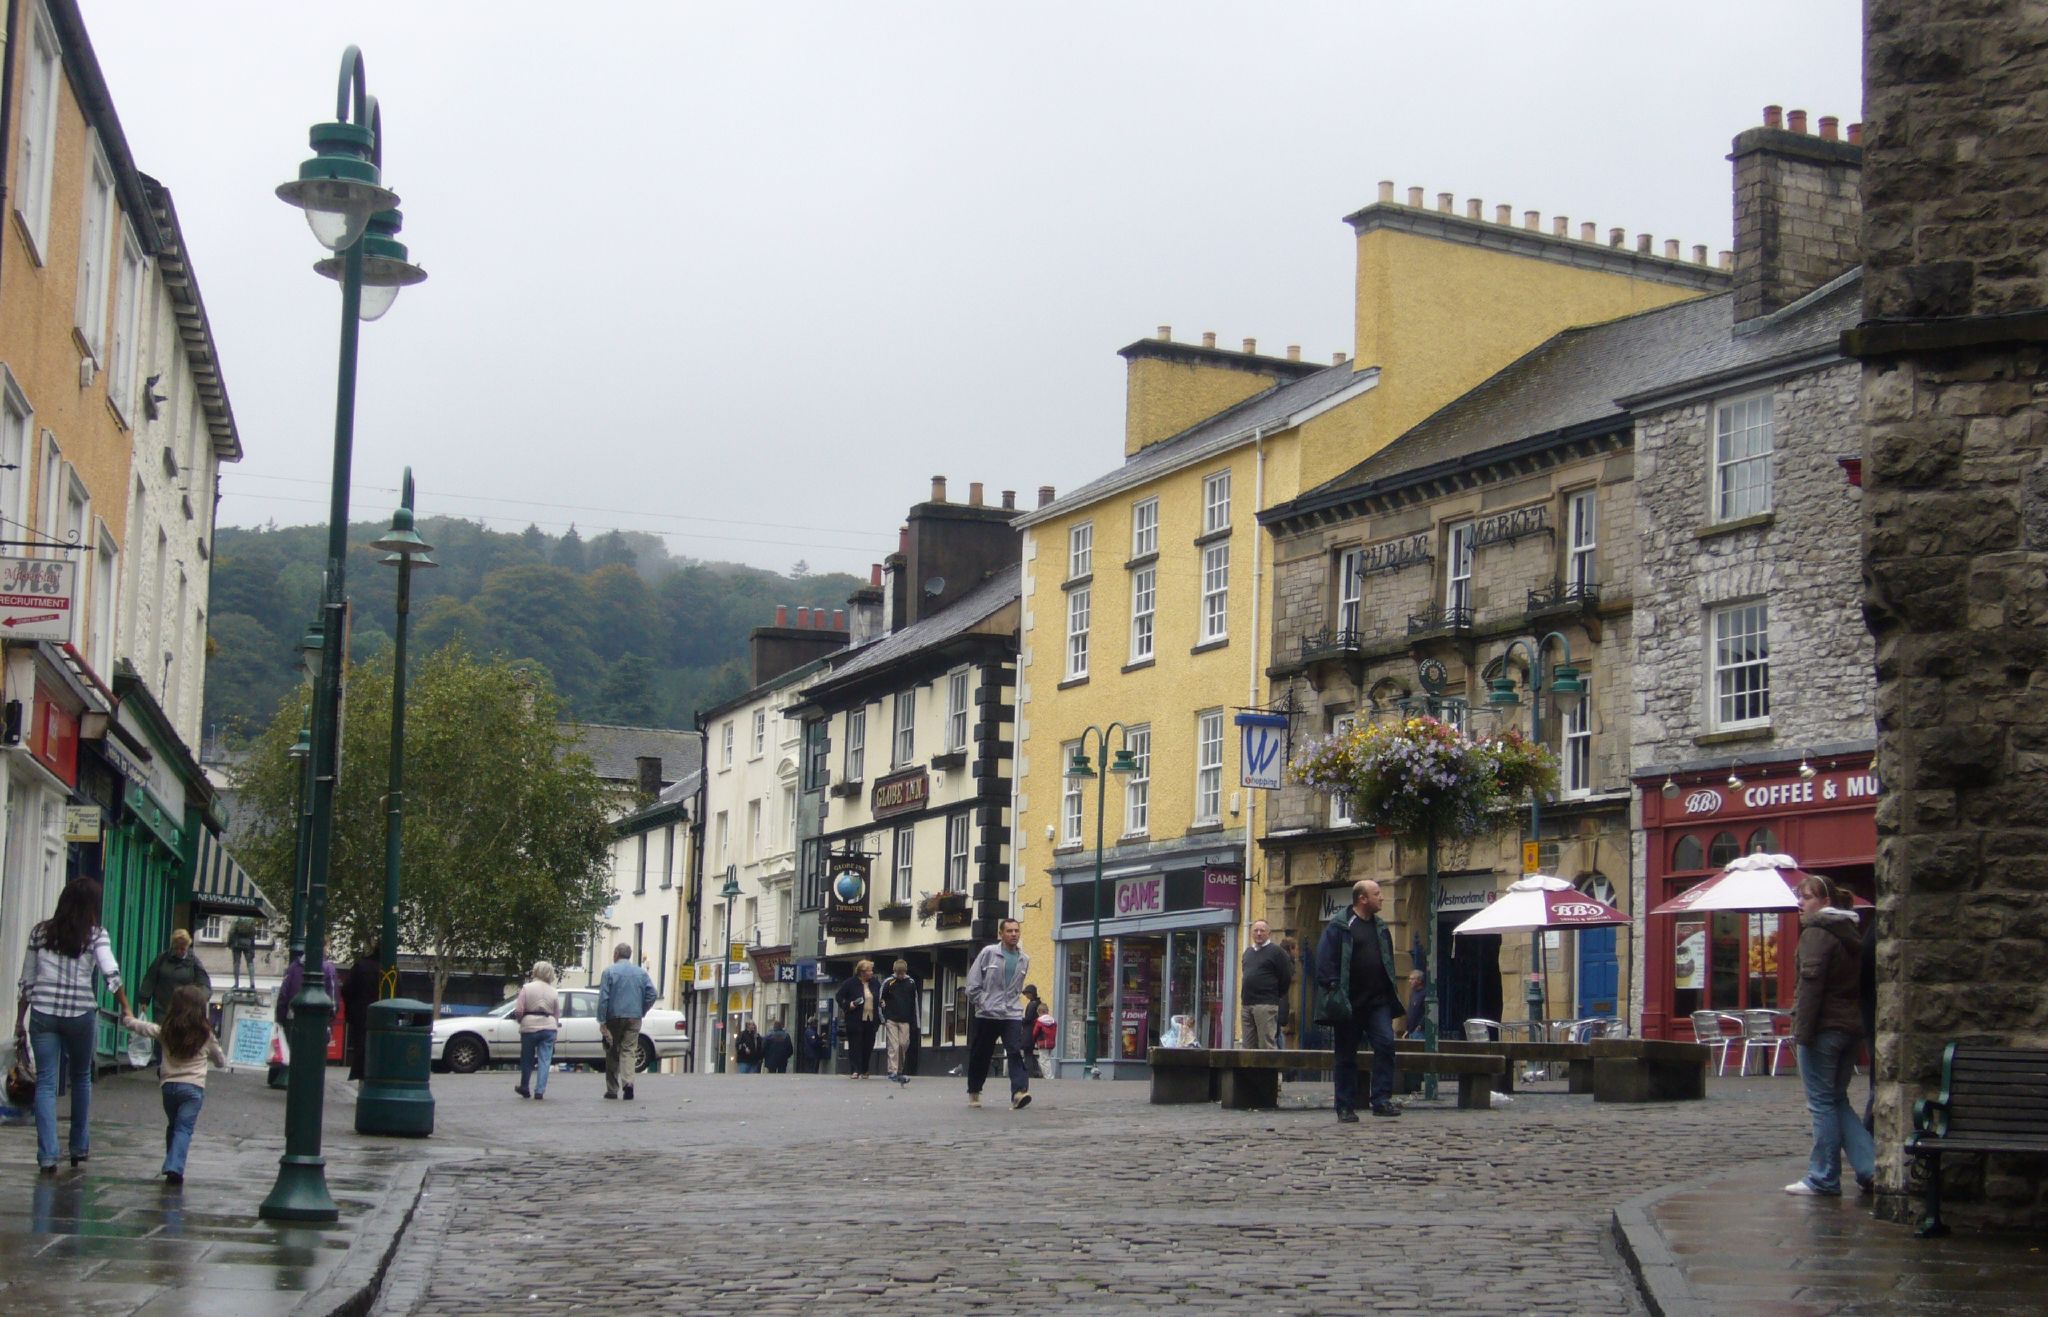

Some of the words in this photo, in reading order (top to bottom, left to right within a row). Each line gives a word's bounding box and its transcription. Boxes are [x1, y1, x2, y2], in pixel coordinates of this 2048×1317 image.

[1360, 535, 1429, 570] PUBLIC
[1470, 505, 1547, 545] MARKET
[1247, 726, 1279, 775] W
[876, 782, 903, 807] GLOBE
[1745, 782, 1813, 807] COFFEE
[1823, 779, 1837, 800] &
[1847, 776, 1878, 798] MU
[1208, 873, 1237, 885] GAME
[197, 893, 256, 906] NEWSAGENTS
[1118, 880, 1160, 913] GAME
